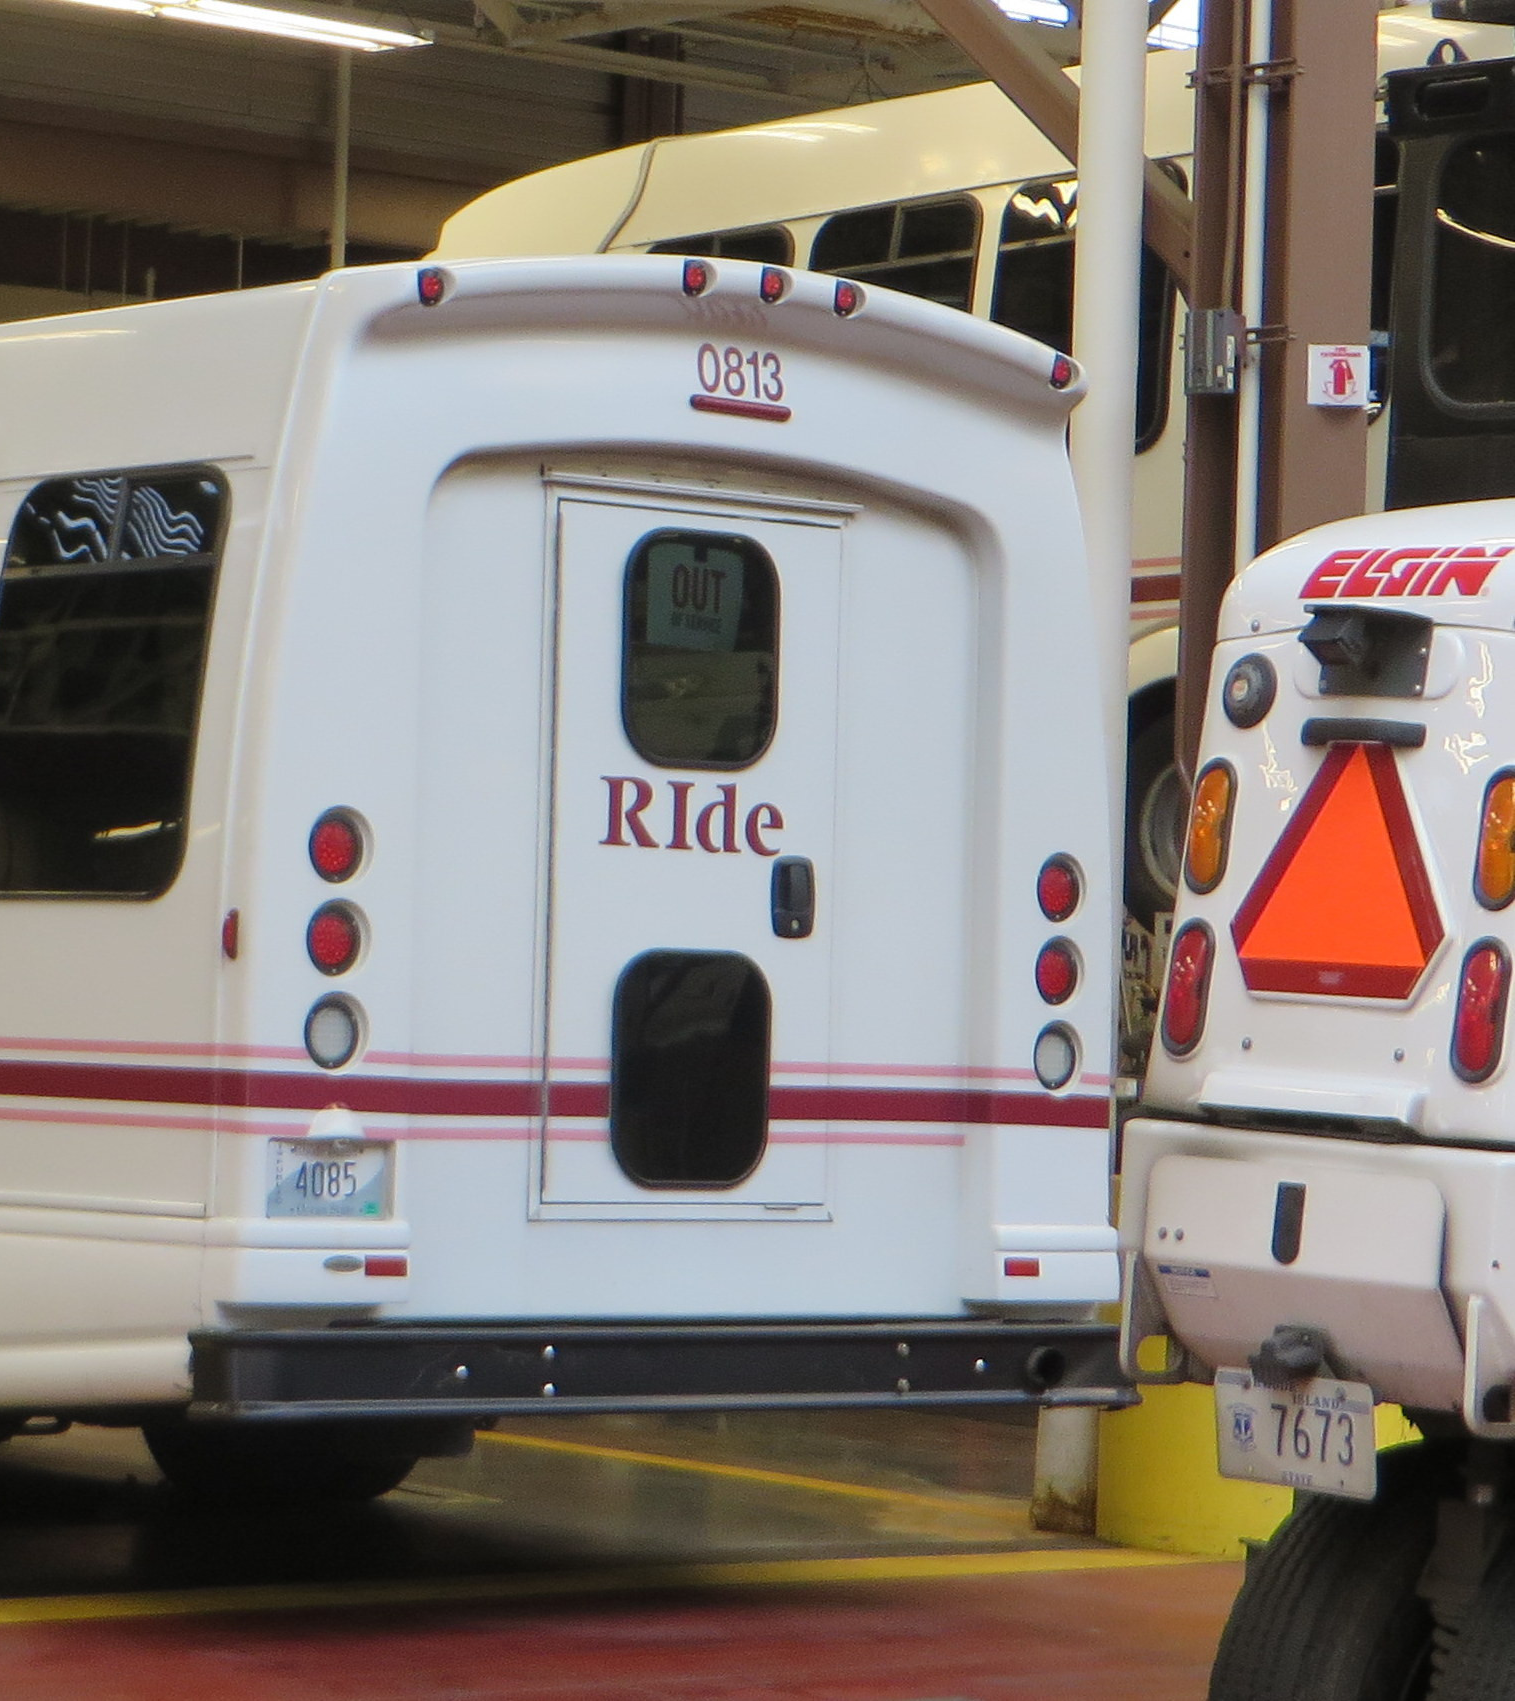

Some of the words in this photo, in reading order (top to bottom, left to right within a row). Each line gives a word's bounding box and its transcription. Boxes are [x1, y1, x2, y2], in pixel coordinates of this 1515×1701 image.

[697, 343, 784, 402] 0813
[672, 564, 726, 614] OUT
[1298, 547, 1515, 599] ELGIN
[598, 775, 784, 857] RIde
[295, 1161, 357, 1197] 4085
[1271, 1403, 1353, 1466] 7673
